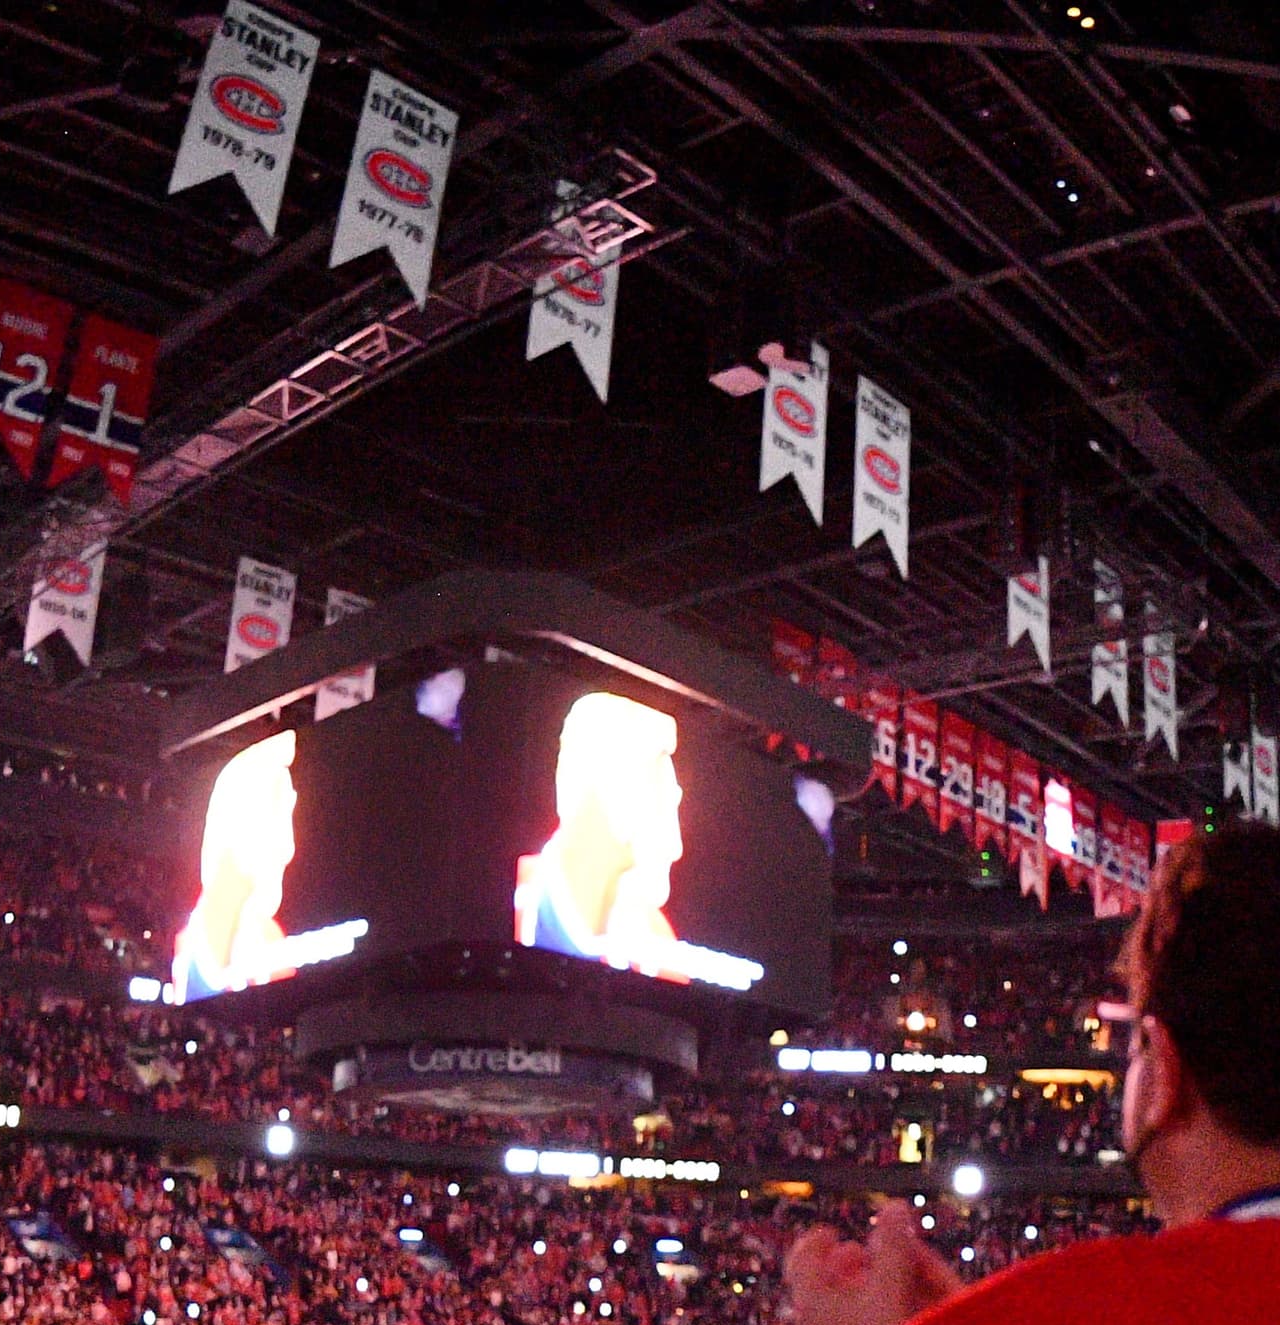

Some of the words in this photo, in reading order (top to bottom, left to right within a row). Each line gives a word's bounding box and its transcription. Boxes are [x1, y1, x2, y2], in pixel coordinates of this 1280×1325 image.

[222, 16, 311, 74] STANLEY
[369, 92, 451, 148] STANLEY
[93, 382, 118, 444] 1
